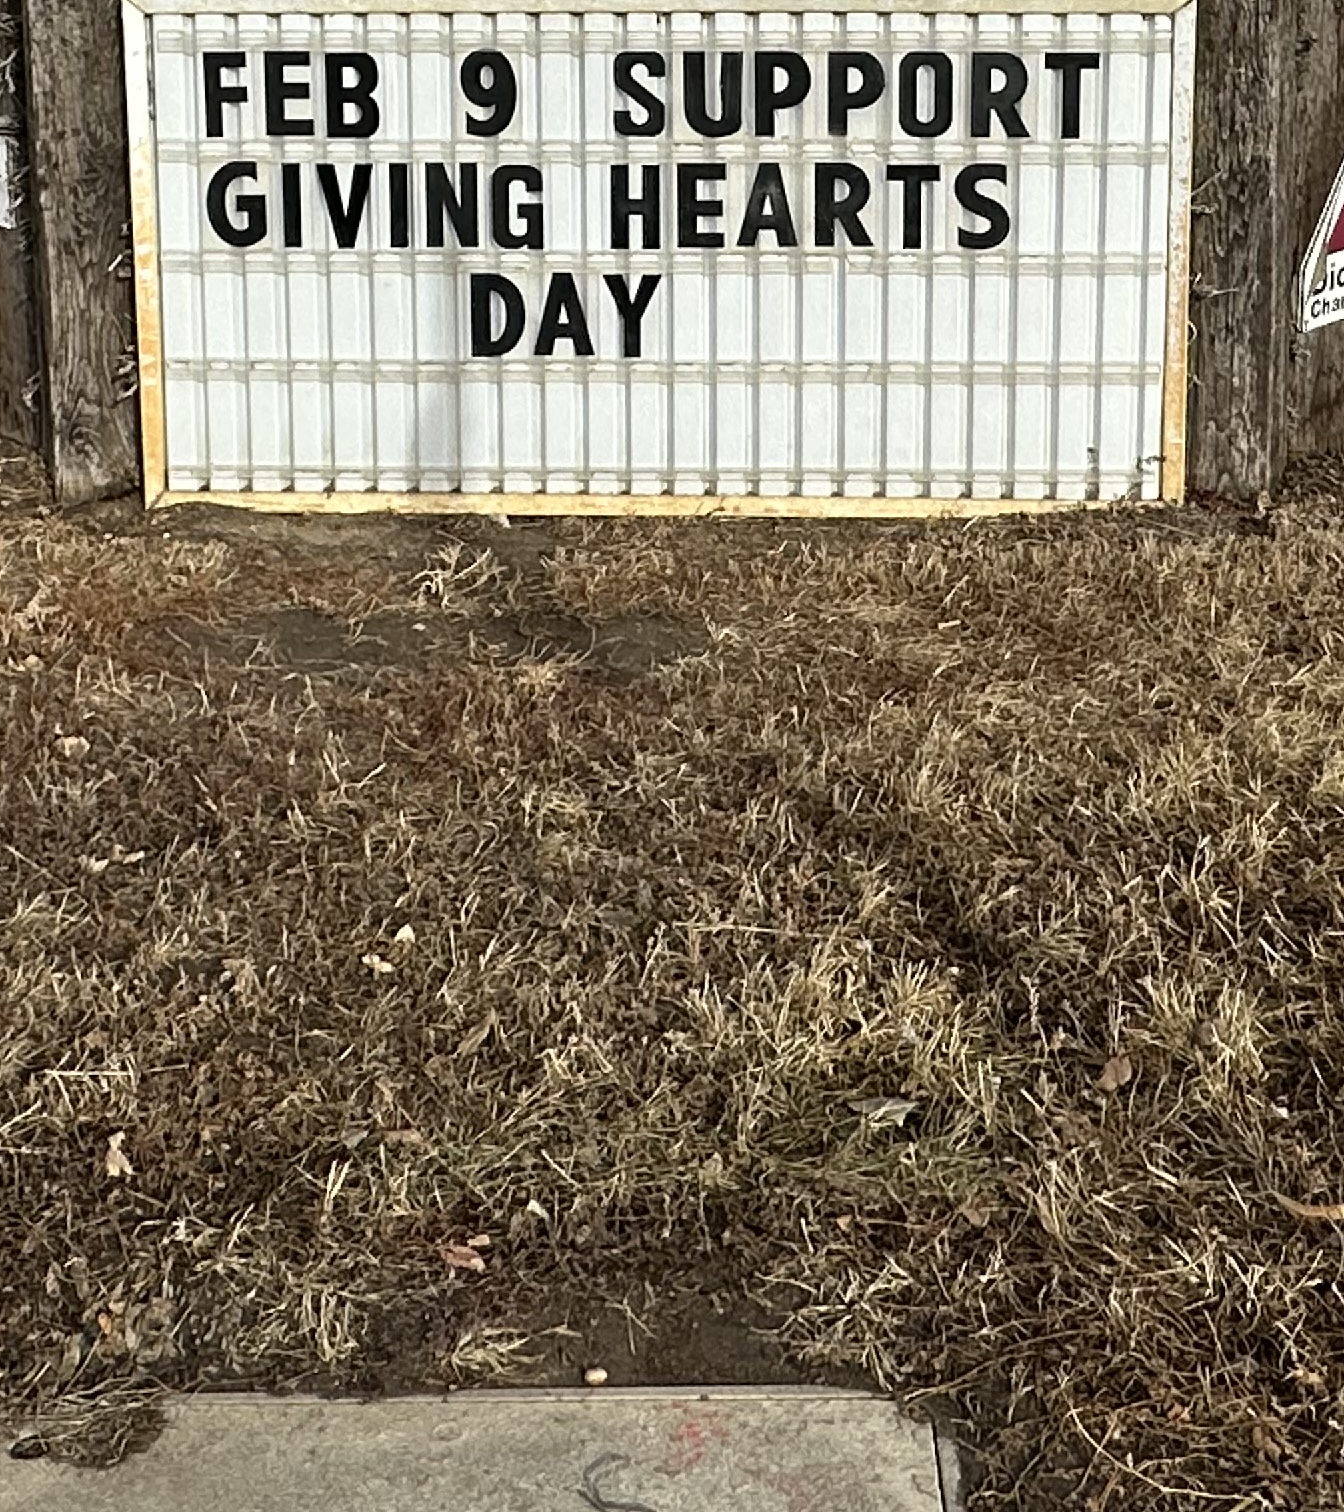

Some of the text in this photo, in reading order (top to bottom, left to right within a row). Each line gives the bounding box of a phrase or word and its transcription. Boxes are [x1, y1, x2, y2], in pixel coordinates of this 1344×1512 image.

[202, 49, 1101, 138] FEB 9 SUPPORT
[206, 160, 1011, 250] GIVING HEARTS
[470, 272, 662, 358] DAY
